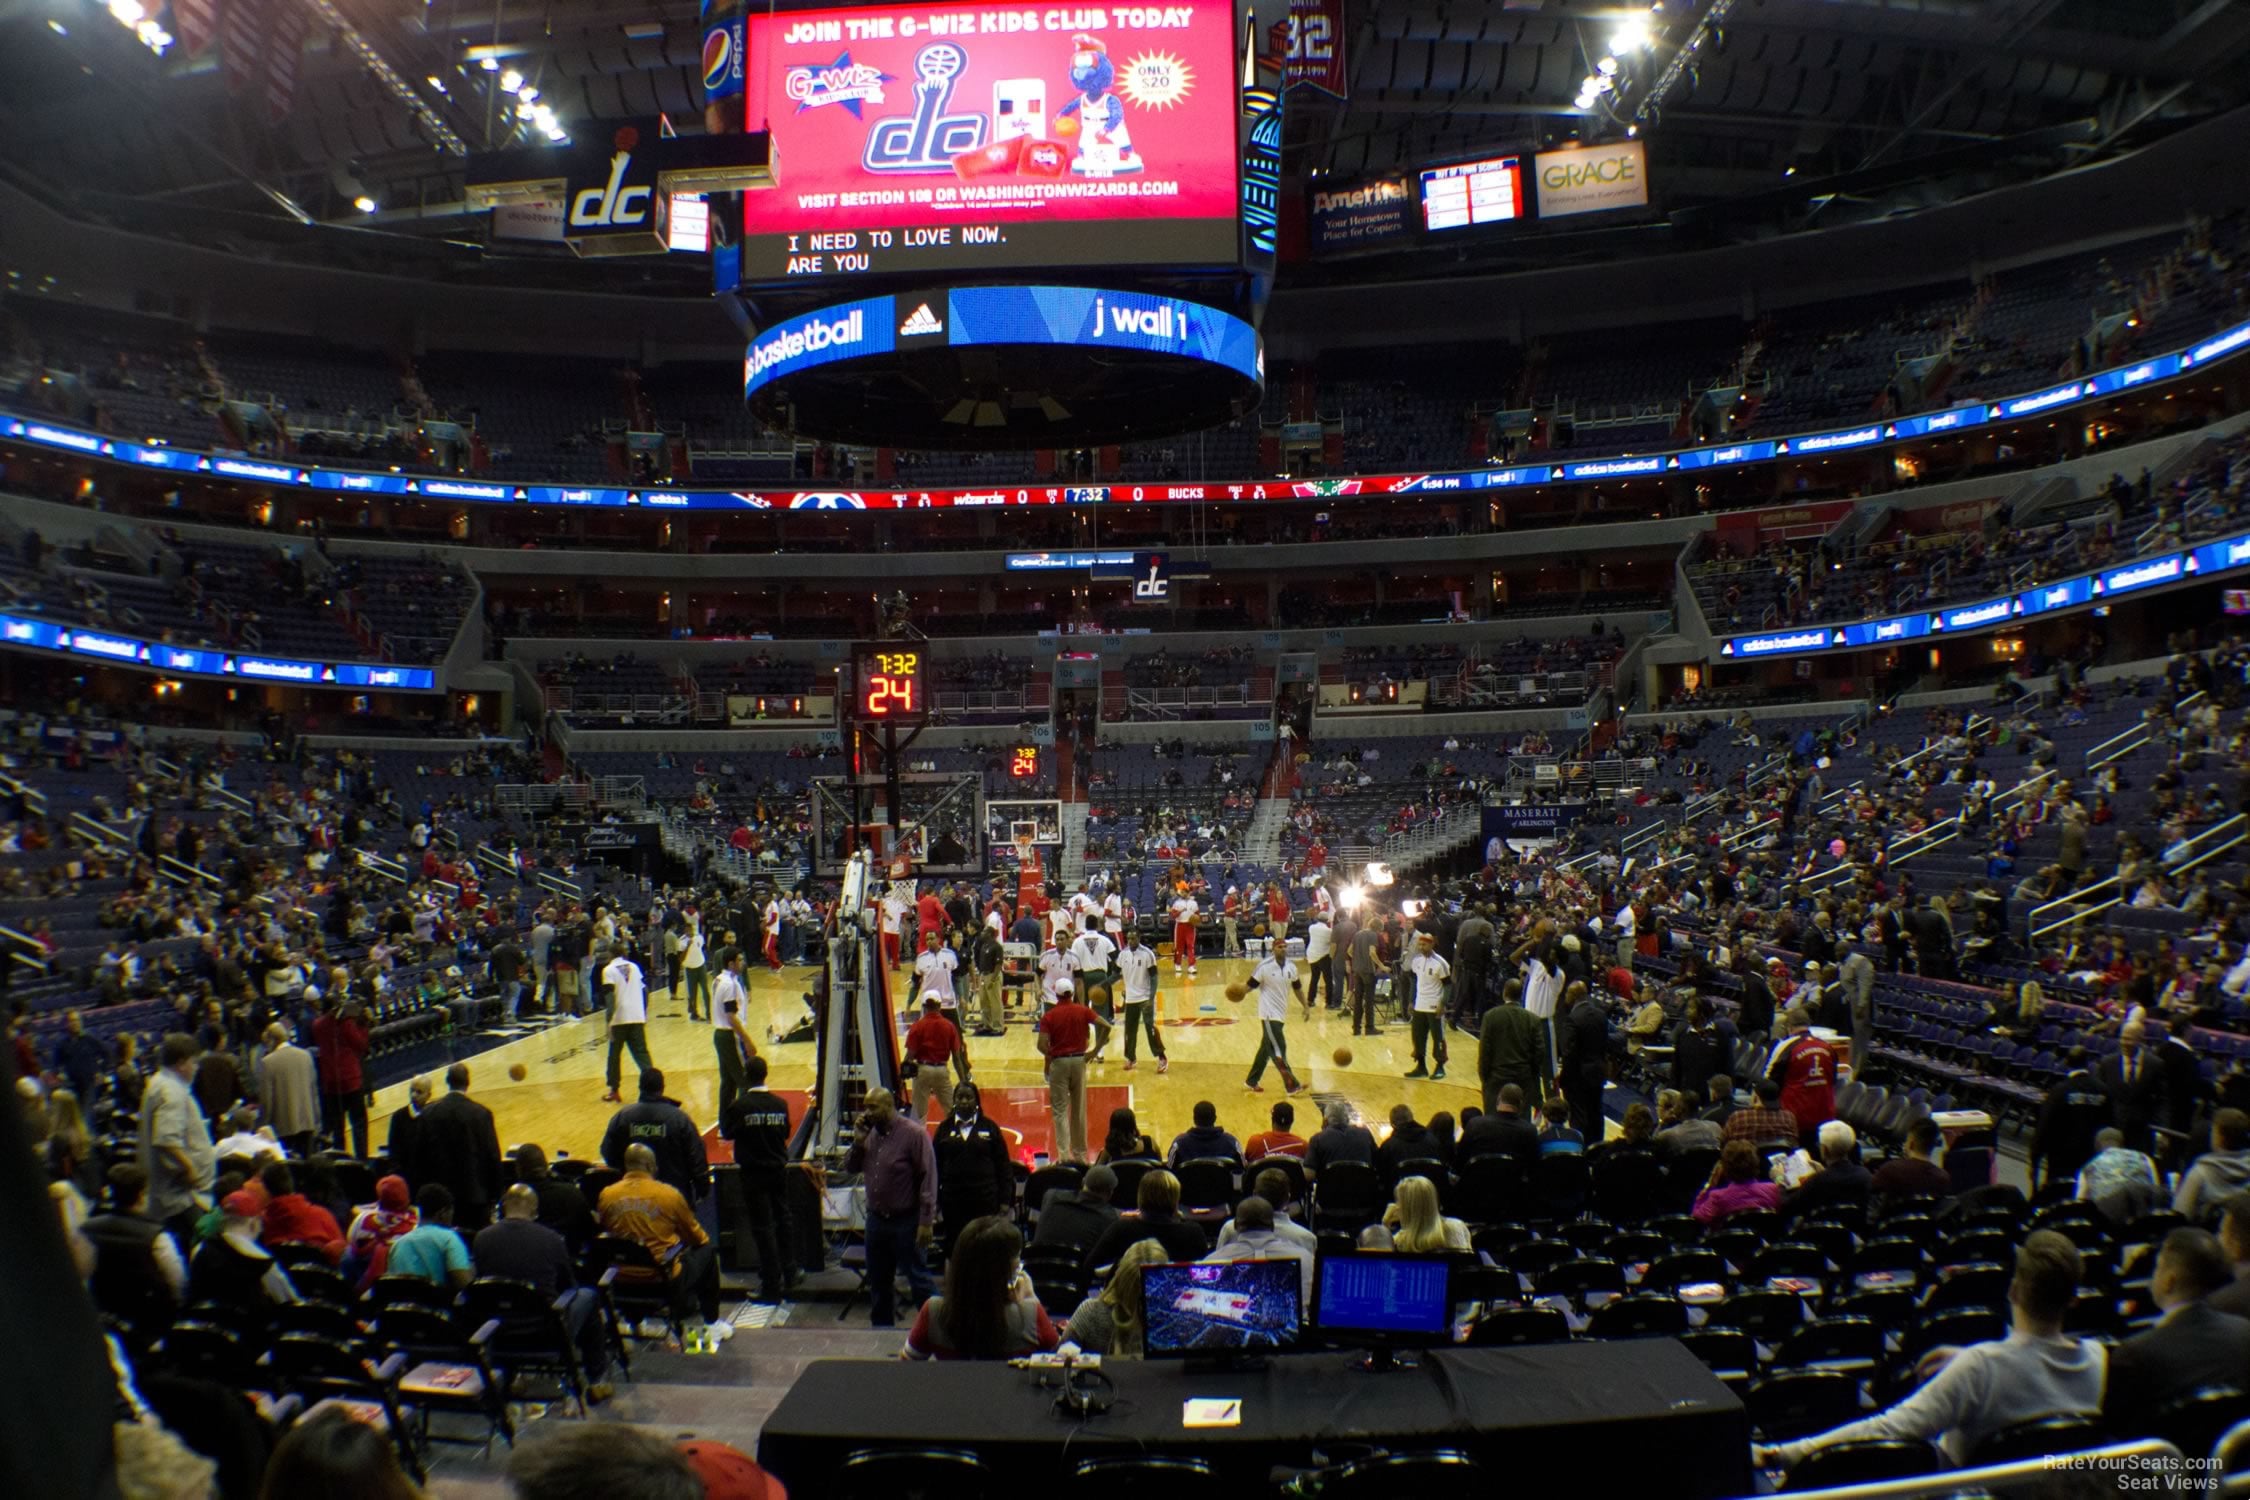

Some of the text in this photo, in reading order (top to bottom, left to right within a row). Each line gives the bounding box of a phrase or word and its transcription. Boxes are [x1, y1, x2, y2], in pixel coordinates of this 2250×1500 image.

[784, 7, 1193, 44] JOIN THE G-WIZ KIDS CLUB TODAY
[731, 24, 743, 79] pepsi
[1138, 65, 1171, 76] ONLY
[1142, 77, 1170, 88] $20
[1542, 155, 1635, 190] GRACE
[569, 151, 651, 226] dc
[798, 193, 838, 208] VISIT
[840, 190, 905, 207] SECTION
[936, 187, 957, 201] OR
[960, 181, 1178, 200] WASHINGTONWIZARDS.COM
[1325, 211, 1400, 230] Your Hometown
[788, 226, 1007, 252] I NEED TO LOVE NOW.
[1323, 222, 1402, 241] Place for Copiers
[787, 254, 870, 274] ARE YOU
[1093, 298, 1187, 341] j wall 1
[753, 309, 863, 375] basketball
[1445, 478, 1459, 488] PM
[954, 490, 1028, 506] wizards 0
[1072, 488, 1204, 501] 7:32 0 BUCKS
[1136, 566, 1168, 596] dc
[1105, 637, 1121, 645] 105
[877, 654, 917, 675] 7:32
[869, 677, 912, 713] 24
[1570, 711, 1586, 720] 104
[821, 732, 837, 740] 107
[1033, 728, 1049, 736] 106
[1253, 722, 1271, 732] 105
[1017, 748, 1035, 758] 7:32
[1013, 759, 1033, 776] 24
[1504, 808, 1561, 818] MASERATI
[1518, 819, 1556, 827] ARLINGTON
